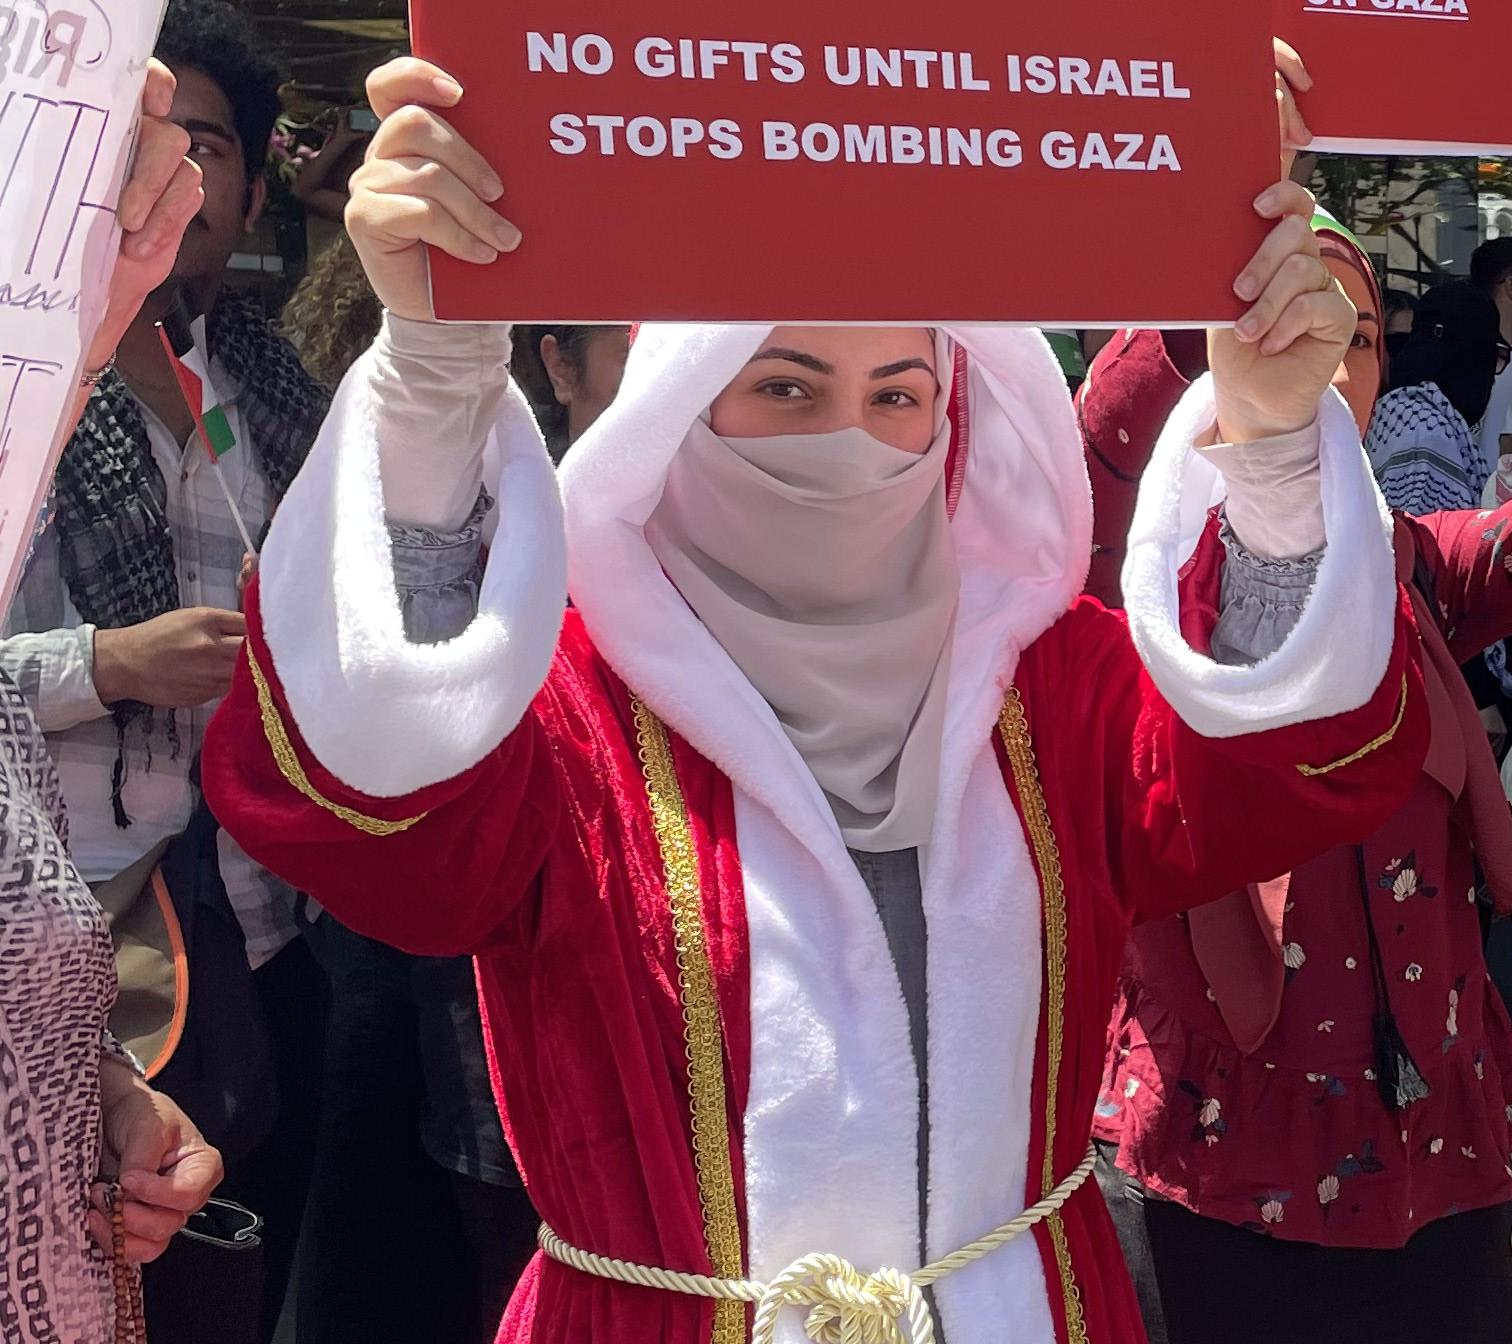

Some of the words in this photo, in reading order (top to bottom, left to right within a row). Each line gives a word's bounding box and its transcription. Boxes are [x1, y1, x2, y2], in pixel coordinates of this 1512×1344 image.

[527, 32, 613, 74] NO
[635, 37, 804, 82] GIFTS
[824, 46, 990, 90] UNTIL
[1008, 55, 1190, 98] ISRAEL
[550, 114, 742, 159] STOPS
[763, 122, 1022, 167] BOMBING
[1041, 131, 1181, 171] GAZA
